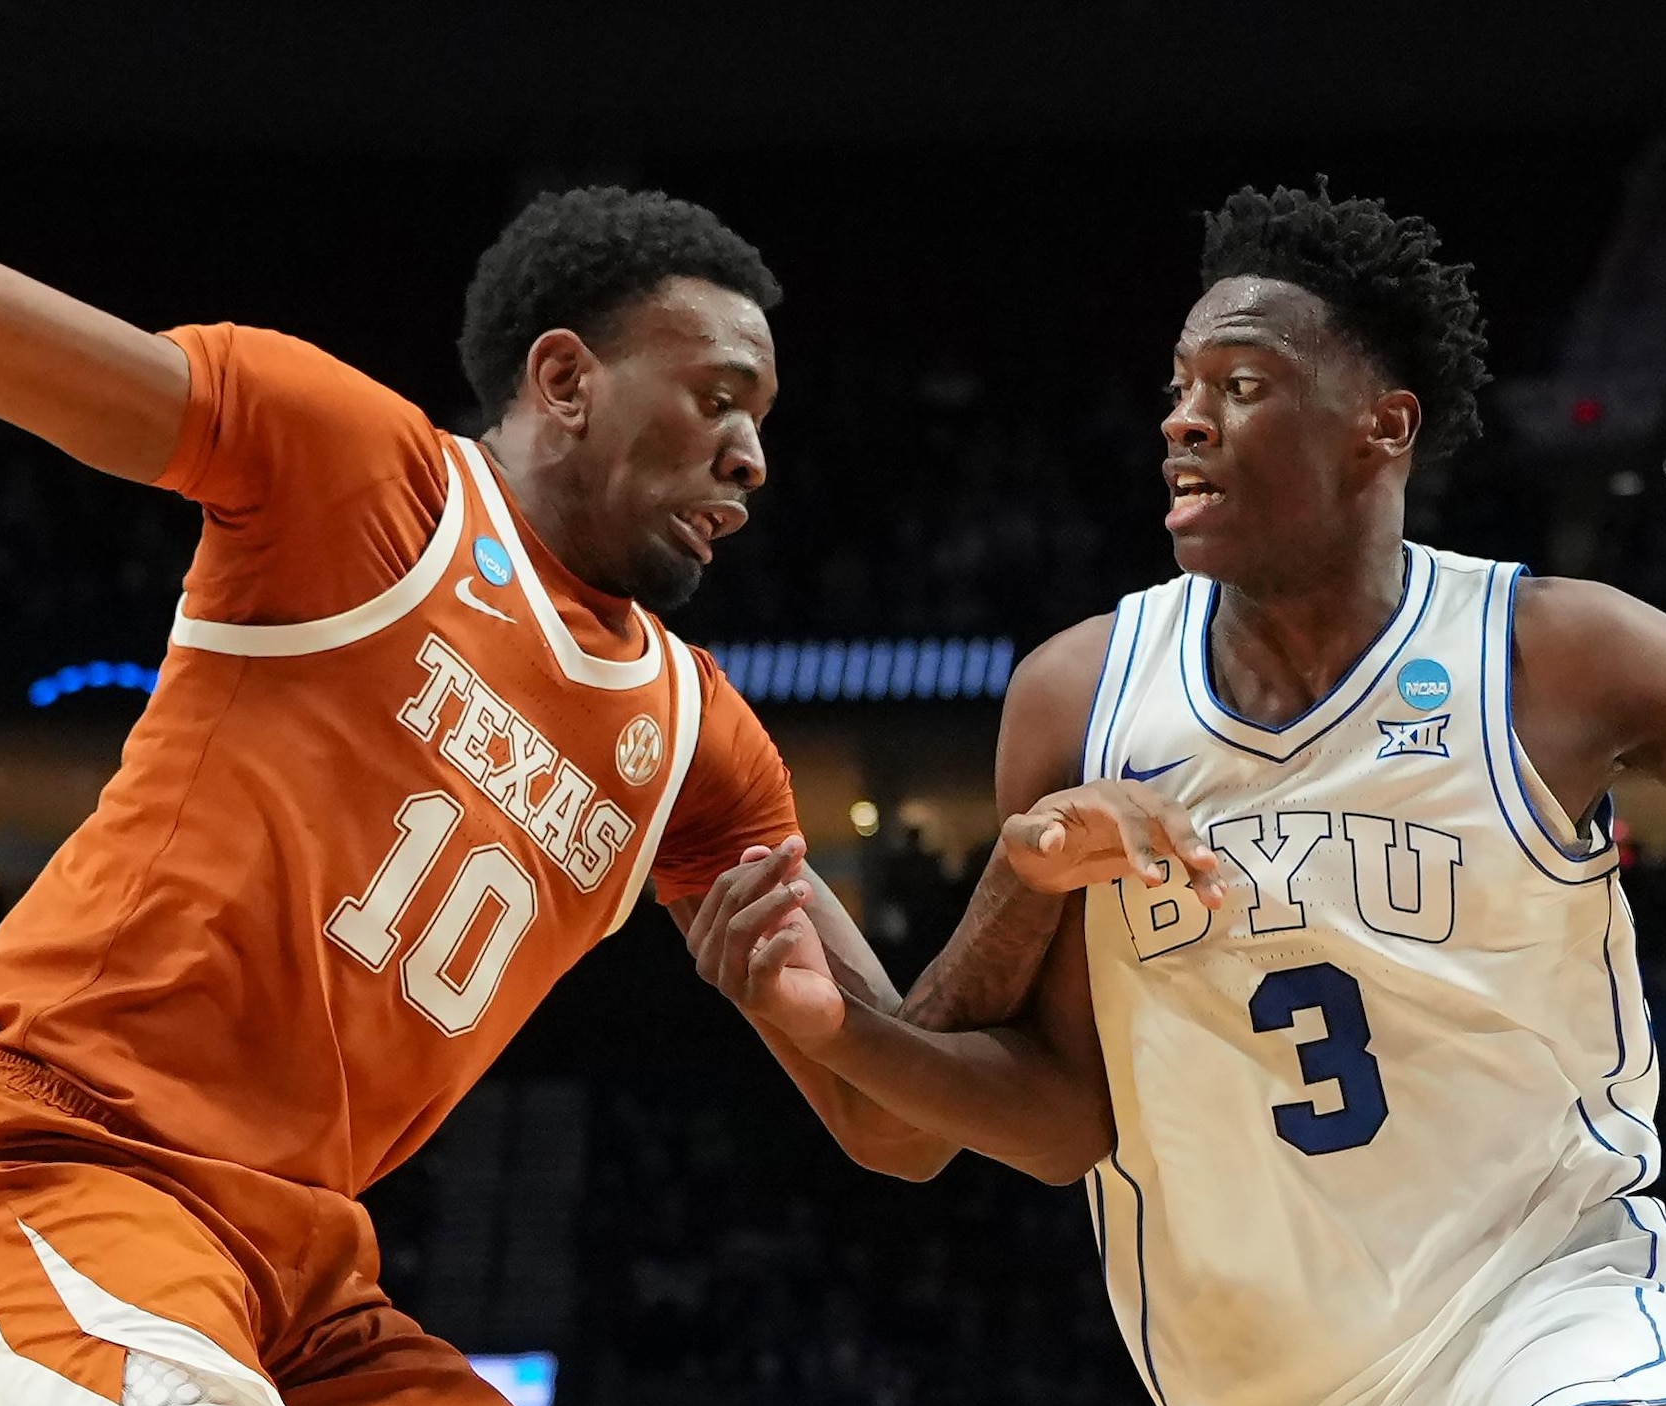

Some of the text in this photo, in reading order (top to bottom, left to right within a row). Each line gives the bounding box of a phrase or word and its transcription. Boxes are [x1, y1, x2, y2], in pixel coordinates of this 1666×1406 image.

[396, 632, 636, 893] TEXAS
[619, 719, 660, 779] SEC
[1406, 682, 1448, 696] NCAA
[323, 790, 537, 1038] 10
[1112, 811, 1464, 961] BYU
[1248, 962, 1389, 1156] 3
